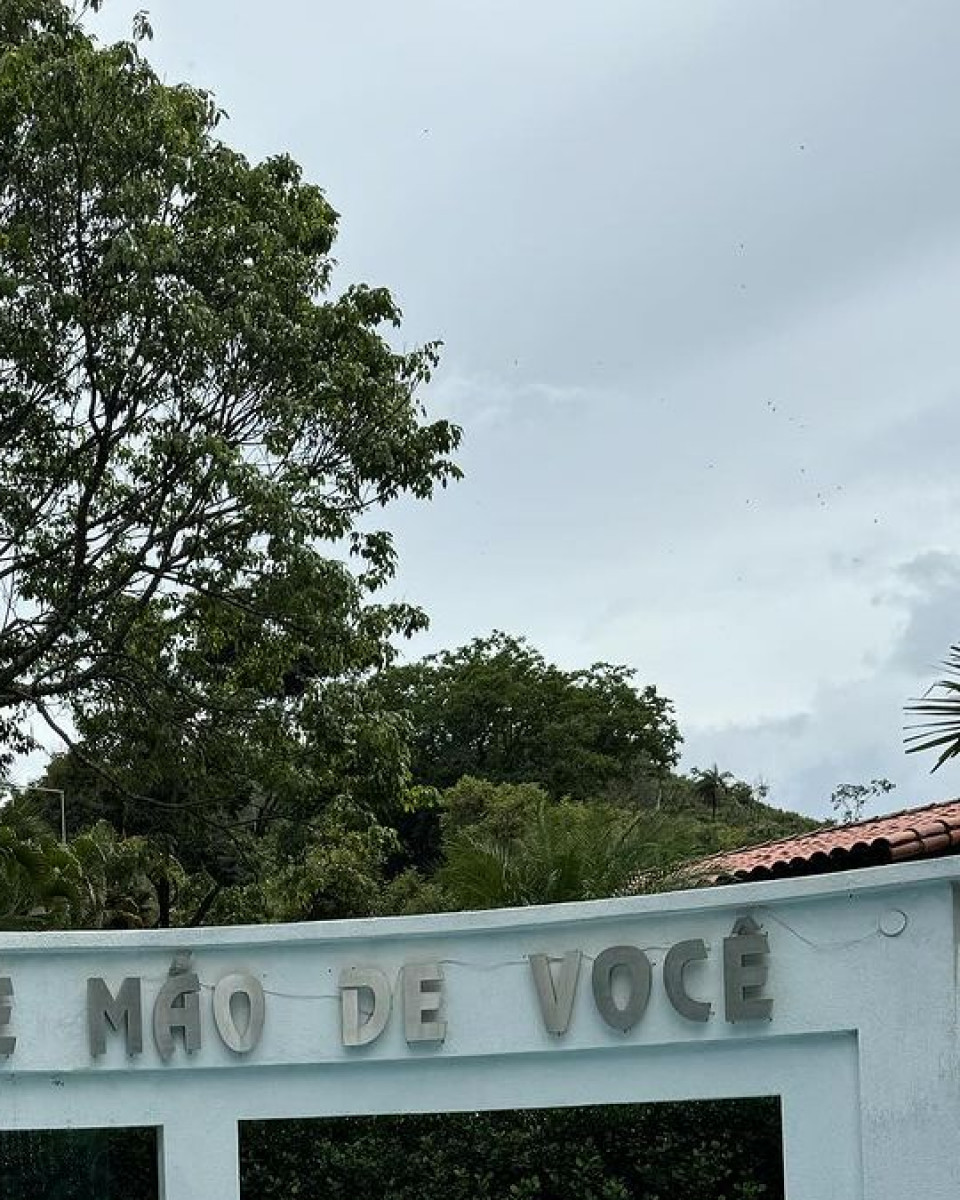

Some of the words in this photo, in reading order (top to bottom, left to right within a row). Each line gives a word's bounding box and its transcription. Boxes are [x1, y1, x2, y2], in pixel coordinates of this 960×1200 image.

[86, 949, 265, 1060] MÃO
[341, 962, 446, 1046] DE
[529, 915, 774, 1036] VOCÊ
